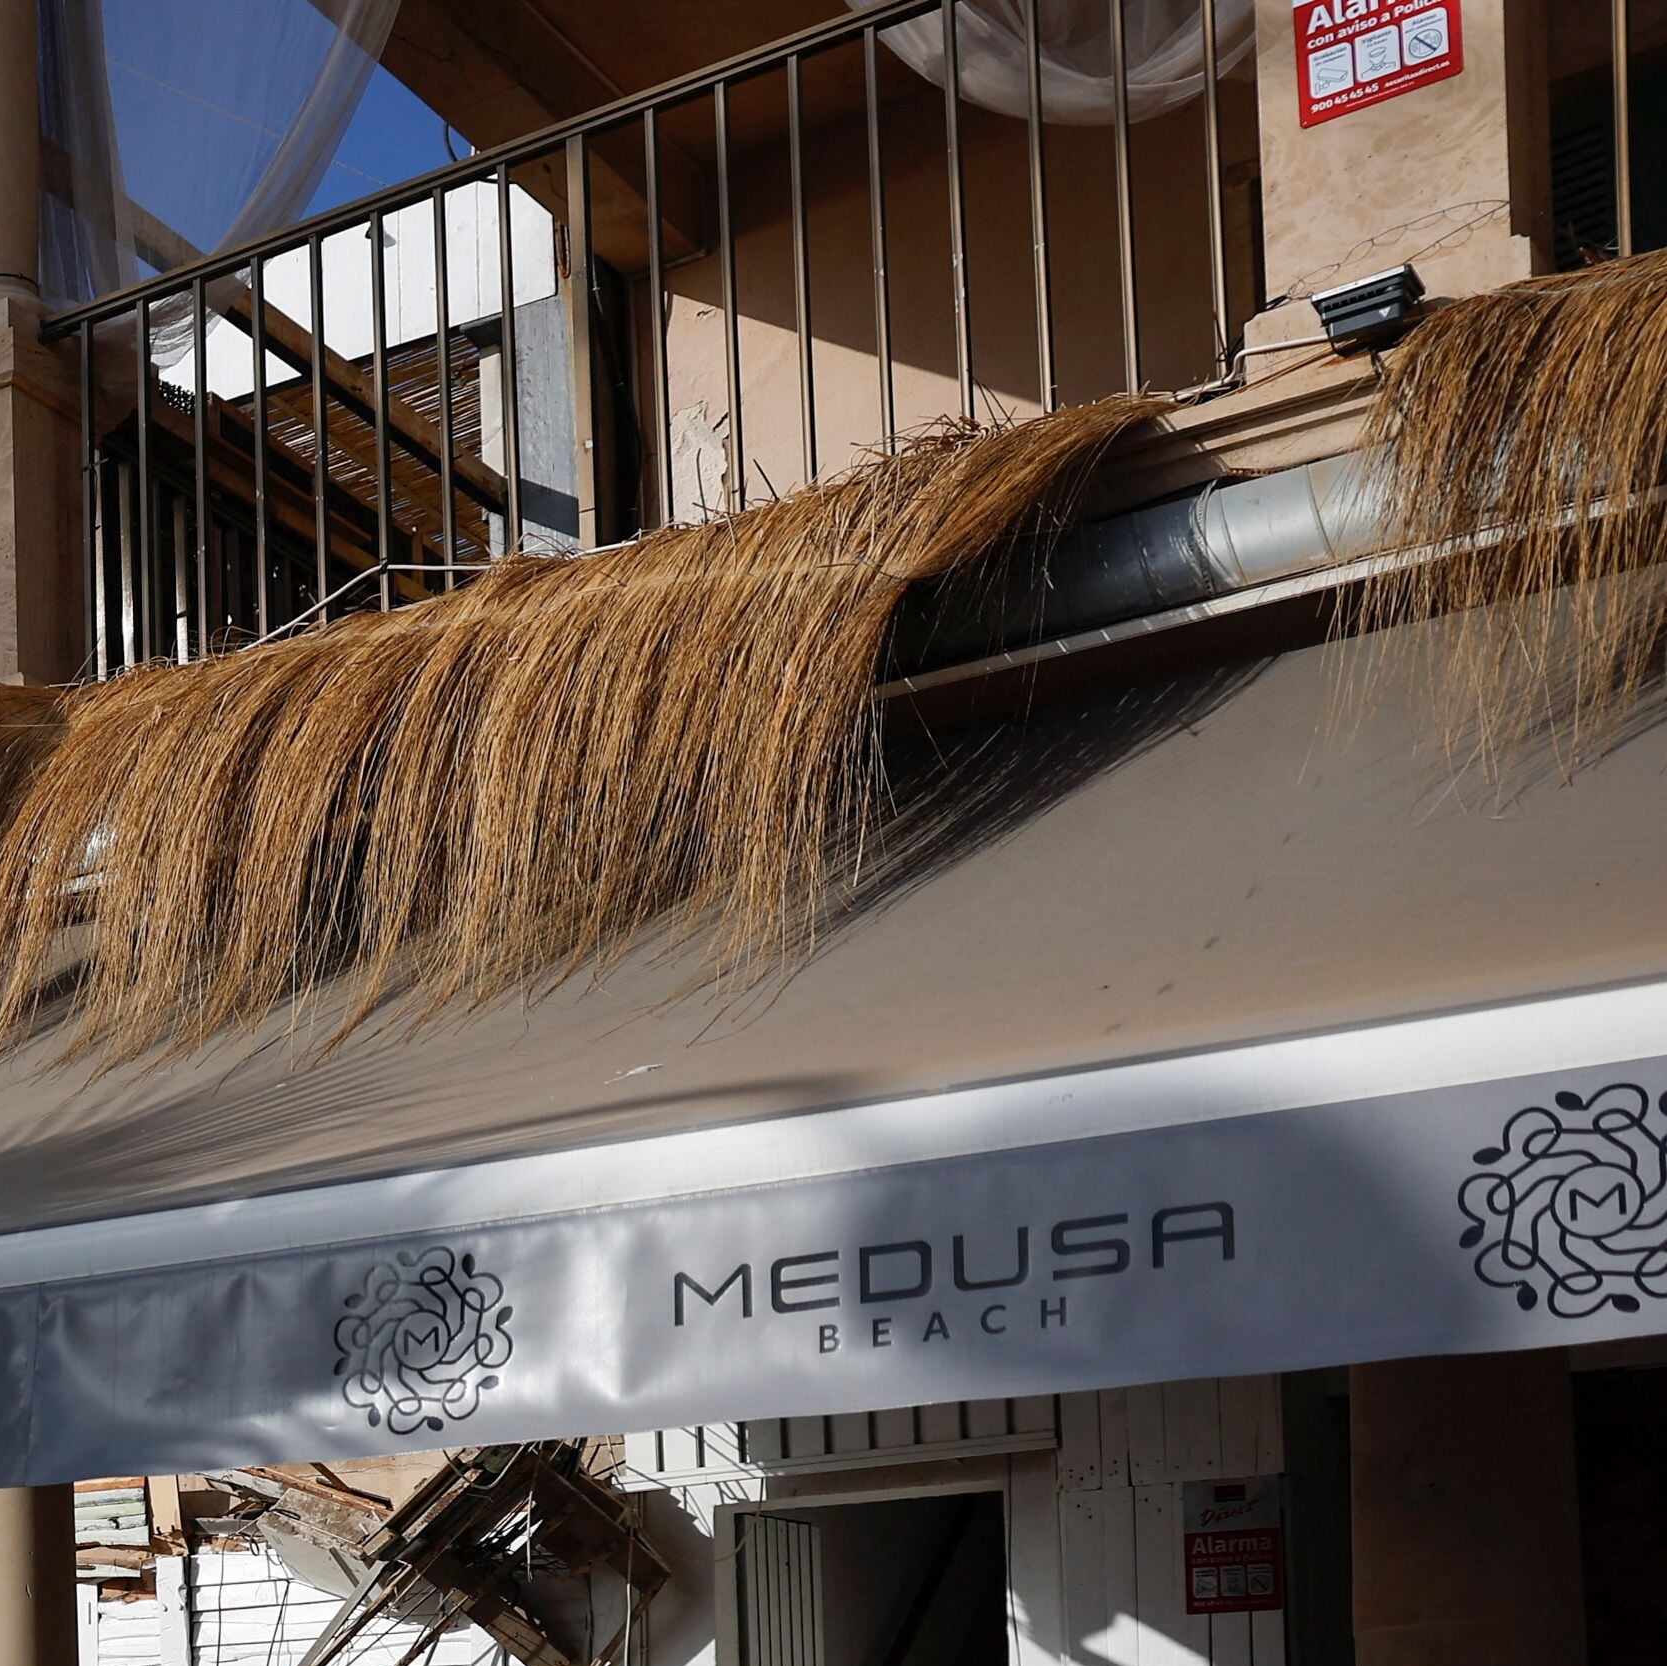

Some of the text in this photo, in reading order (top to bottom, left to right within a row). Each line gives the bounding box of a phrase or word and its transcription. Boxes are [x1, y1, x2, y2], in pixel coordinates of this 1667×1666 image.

[1307, 34, 1334, 49] con
[1337, 17, 1378, 39] aviso
[1380, 12, 1391, 22] a
[1310, 100, 1333, 114] 900
[1334, 93, 1348, 105] 45
[1349, 88, 1364, 99] 45
[1365, 82, 1380, 94] 45
[673, 1201, 1235, 1326] MEDUSA
[818, 1296, 1068, 1354] BEACH
[1192, 1535, 1273, 1556] Alarma
